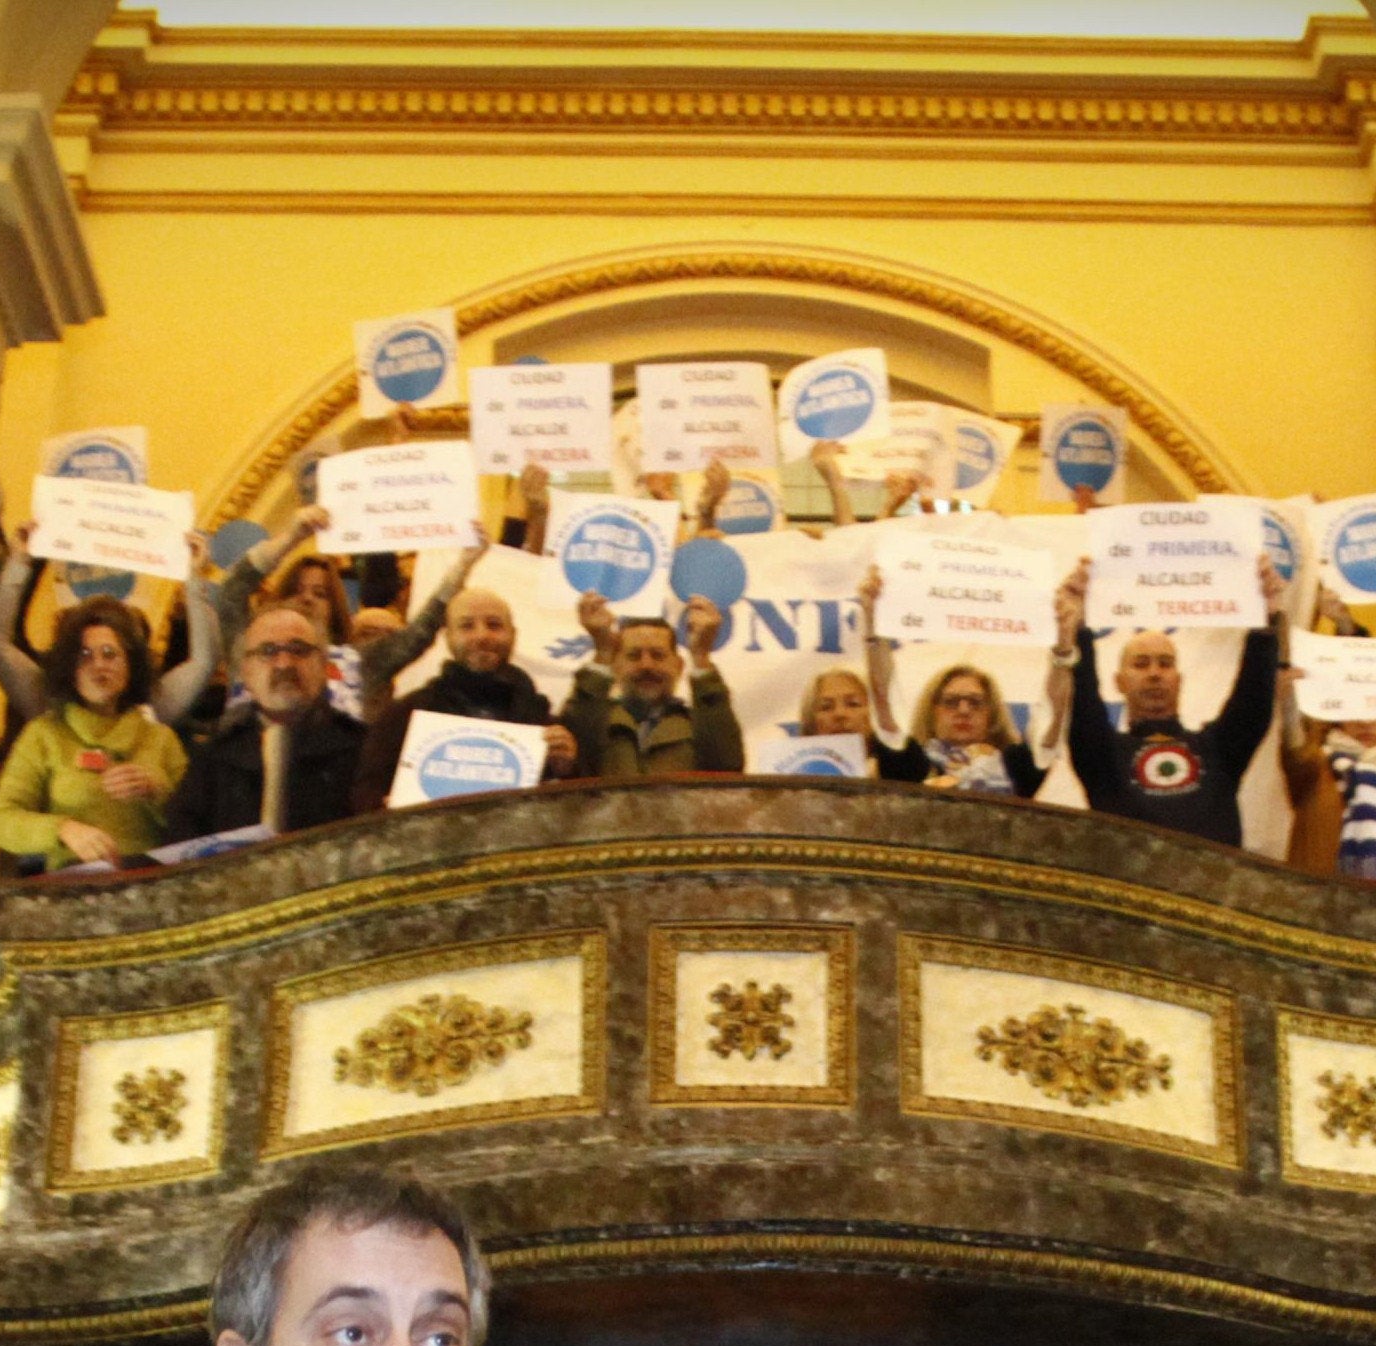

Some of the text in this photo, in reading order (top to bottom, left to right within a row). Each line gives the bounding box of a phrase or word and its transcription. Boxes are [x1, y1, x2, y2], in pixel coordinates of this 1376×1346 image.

[1140, 511, 1210, 525] CIUDAD
[1137, 571, 1213, 586] ALCALDE
[927, 586, 1005, 603] ALCALDE
[1157, 600, 1240, 615] TERCERA
[946, 614, 1029, 633] TERCERA
